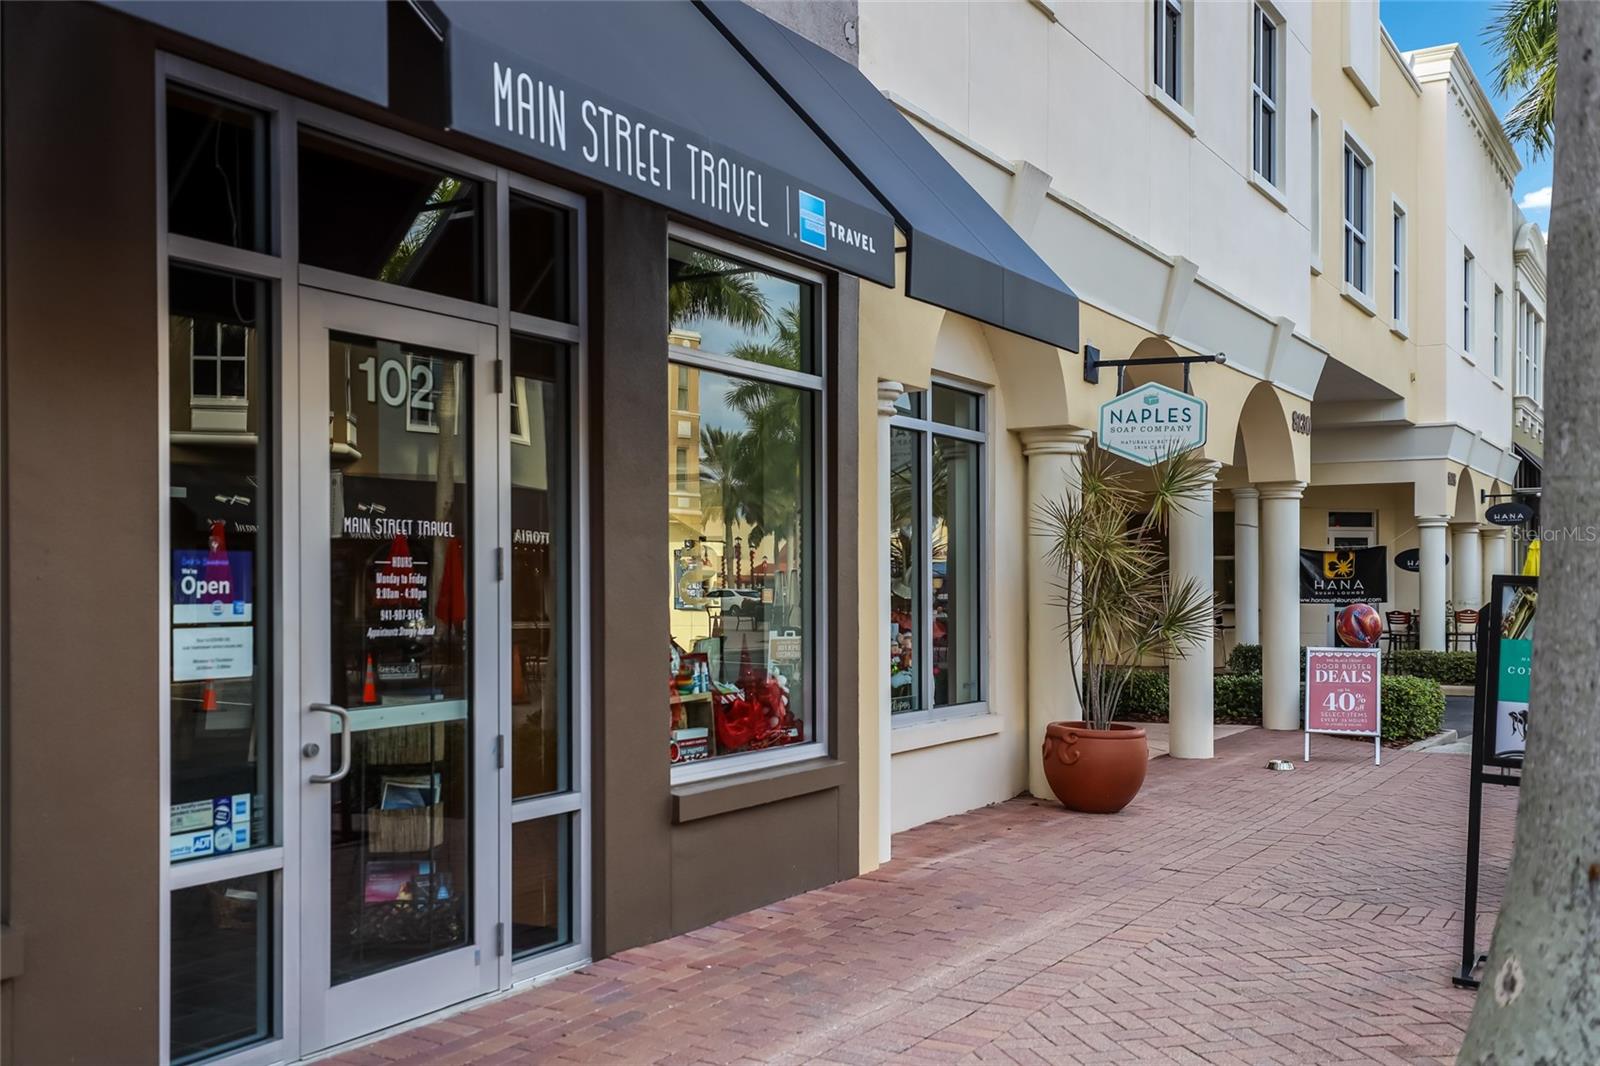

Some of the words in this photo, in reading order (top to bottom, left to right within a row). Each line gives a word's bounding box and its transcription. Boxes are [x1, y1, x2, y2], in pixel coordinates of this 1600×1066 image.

[493, 62, 566, 151] MAIN
[581, 99, 675, 191] STREET
[686, 143, 769, 228] TRAVEL
[829, 220, 876, 254] TRAVEL
[358, 357, 434, 410] 102
[1110, 407, 1192, 425] NAPLES
[1140, 425, 1192, 433] COMPANY
[1494, 512, 1525, 520] HANA
[344, 516, 371, 535] MAIN
[375, 518, 414, 536] STREET
[417, 520, 455, 538] TRAVEL
[181, 575, 231, 599] Open
[408, 573, 427, 587] Friday
[1314, 579, 1364, 590] HANA
[1315, 670, 1372, 683] DEALS
